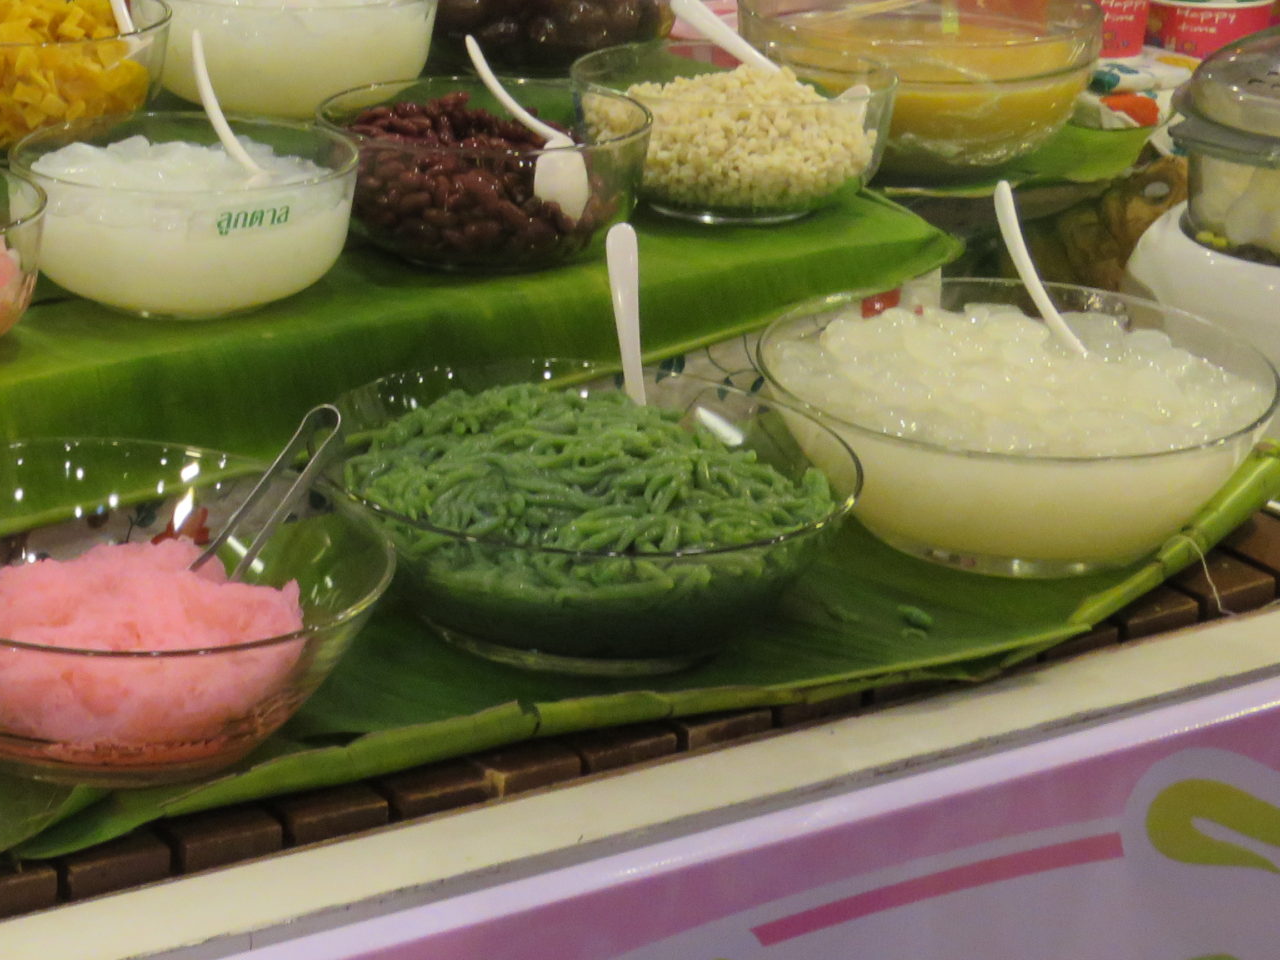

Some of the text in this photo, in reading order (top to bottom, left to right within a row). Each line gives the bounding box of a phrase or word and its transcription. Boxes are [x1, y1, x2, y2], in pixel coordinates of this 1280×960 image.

[1176, 7, 1237, 24] Happy
[216, 205, 290, 237] ลูกตาล
